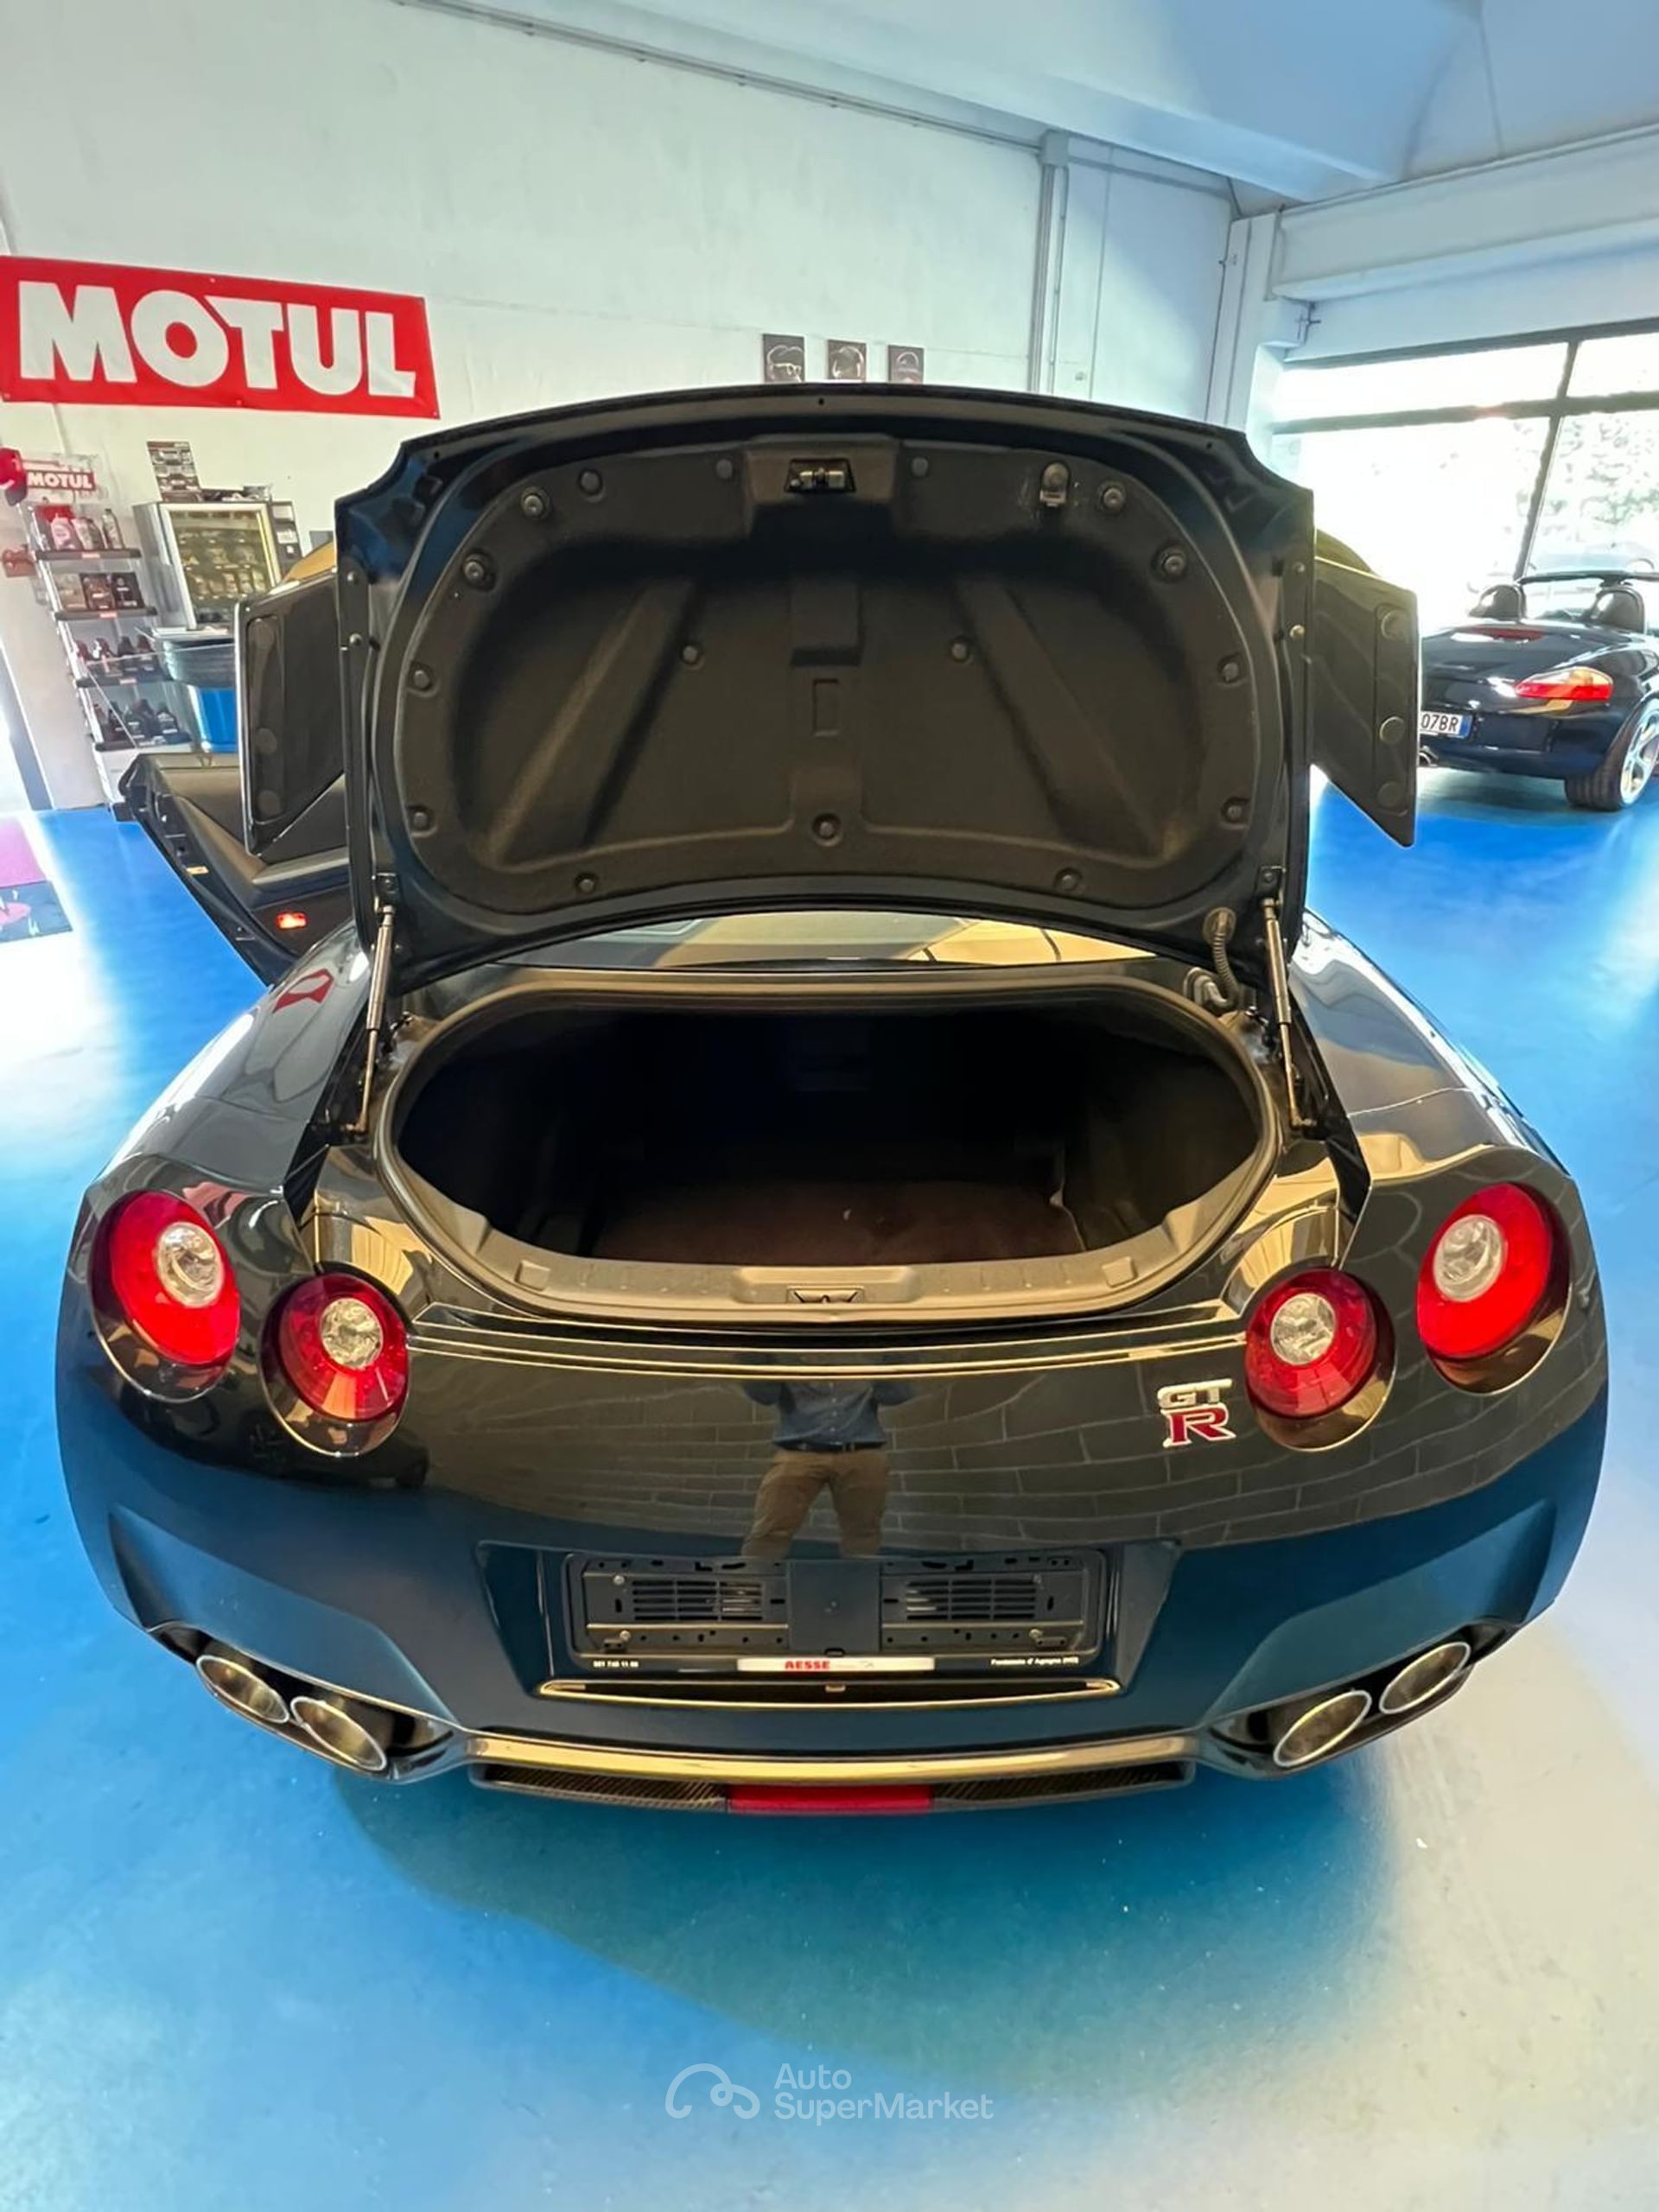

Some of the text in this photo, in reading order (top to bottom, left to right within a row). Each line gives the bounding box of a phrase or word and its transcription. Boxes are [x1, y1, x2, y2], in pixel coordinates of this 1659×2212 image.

[18, 280, 416, 398] MOTUL
[27, 471, 92, 489] MOTUL
[1421, 713, 1459, 732] 07BR
[1157, 1378, 1233, 1408] GT
[1160, 1402, 1236, 1448] R
[785, 1660, 830, 1670] AESSE
